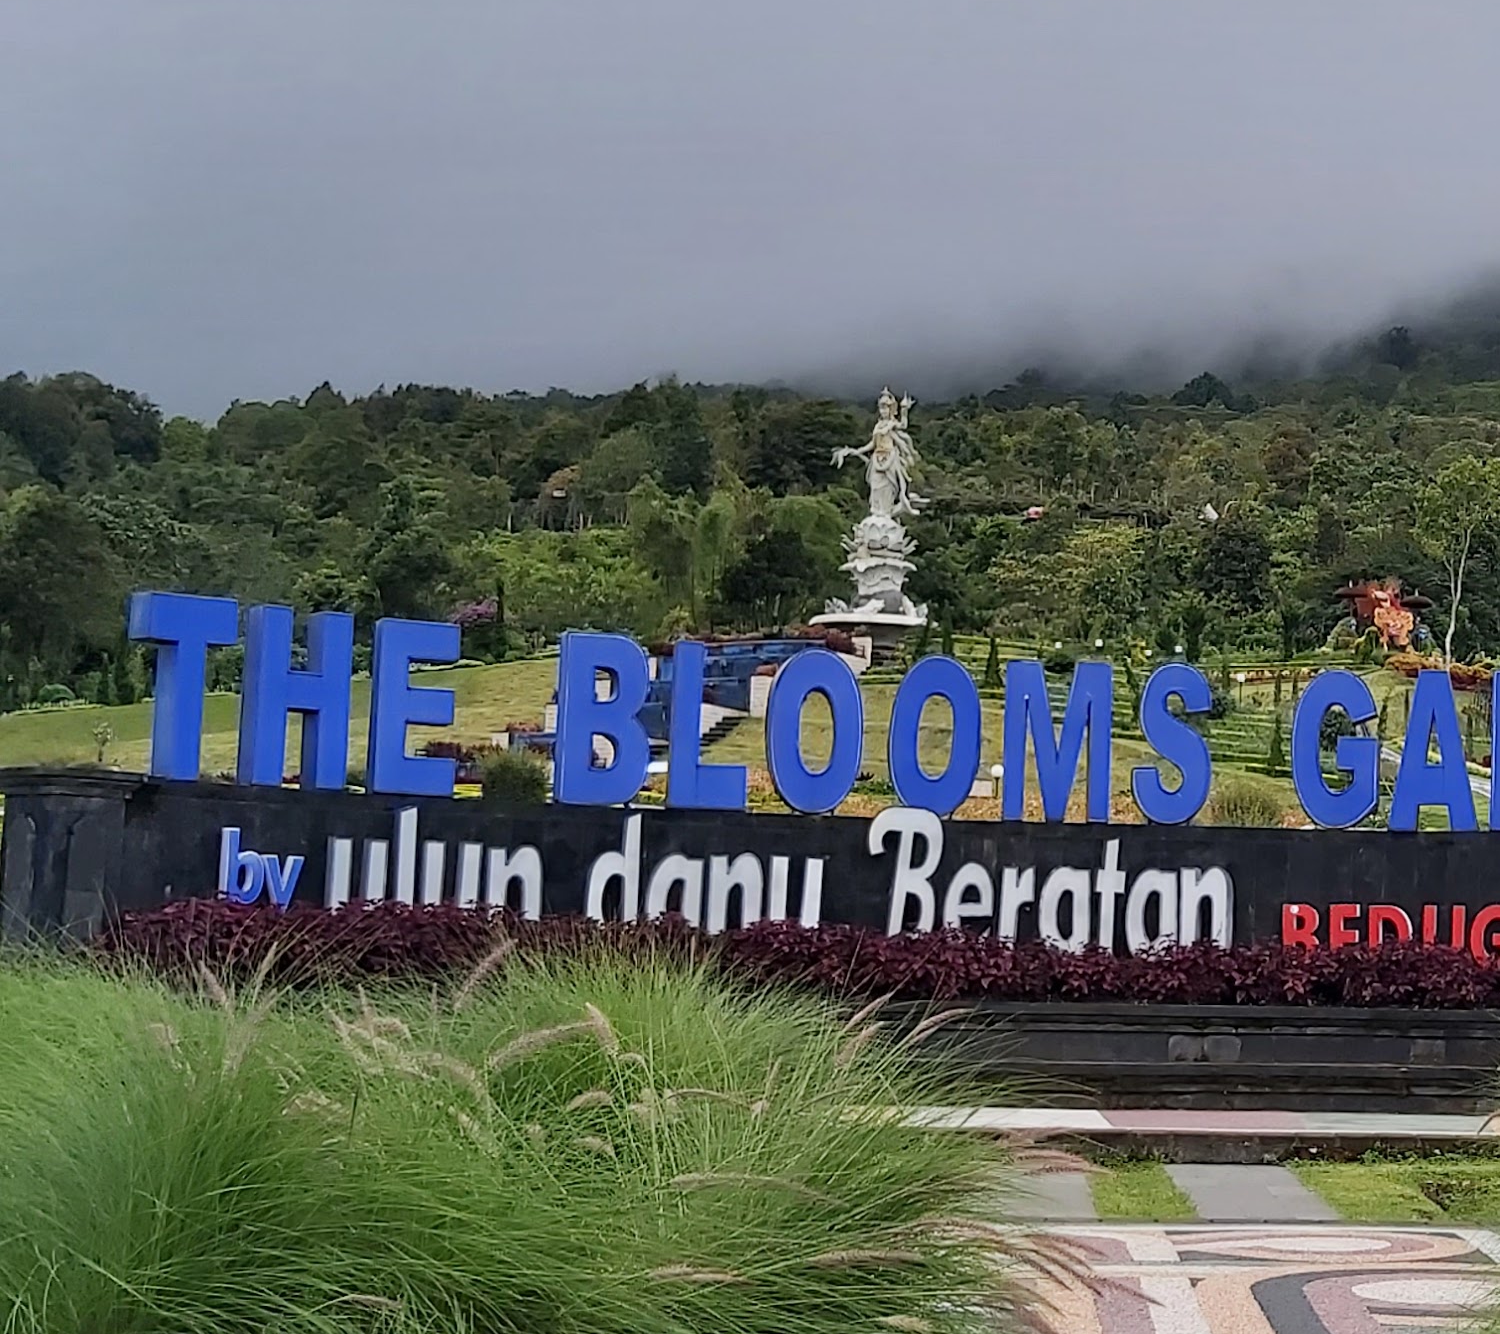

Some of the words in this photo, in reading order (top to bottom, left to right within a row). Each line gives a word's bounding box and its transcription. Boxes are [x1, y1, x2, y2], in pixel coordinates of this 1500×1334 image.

[130, 591, 461, 798] THE
[553, 631, 1213, 825] BLOOMS
[218, 827, 304, 911] by
[324, 806, 544, 923] ulun
[585, 813, 824, 935] danu
[868, 806, 1234, 957] Beratan
